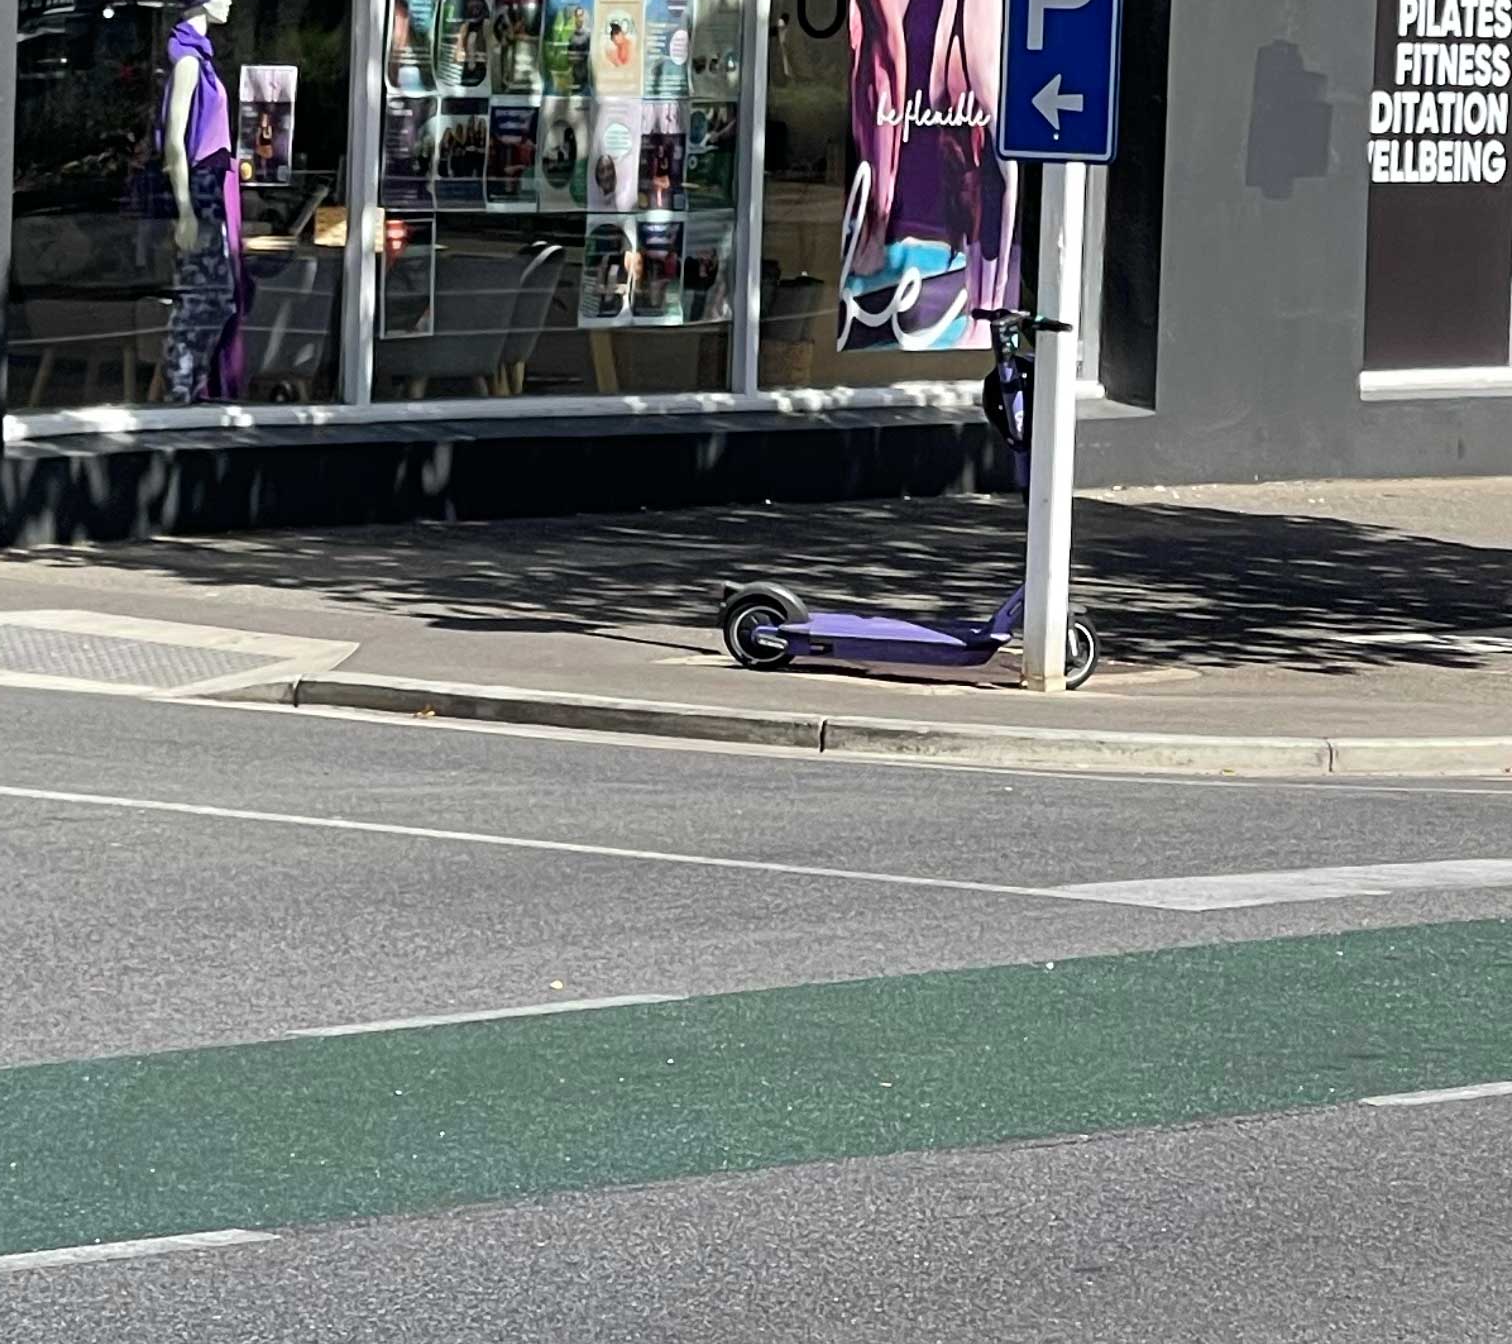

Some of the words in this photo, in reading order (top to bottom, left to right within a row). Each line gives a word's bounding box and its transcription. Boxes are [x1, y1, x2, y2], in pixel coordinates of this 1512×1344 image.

[1395, 41, 1511, 87] FITNESS
[1369, 89, 1509, 135] DITATION
[1367, 139, 1507, 184] ELLBEING
